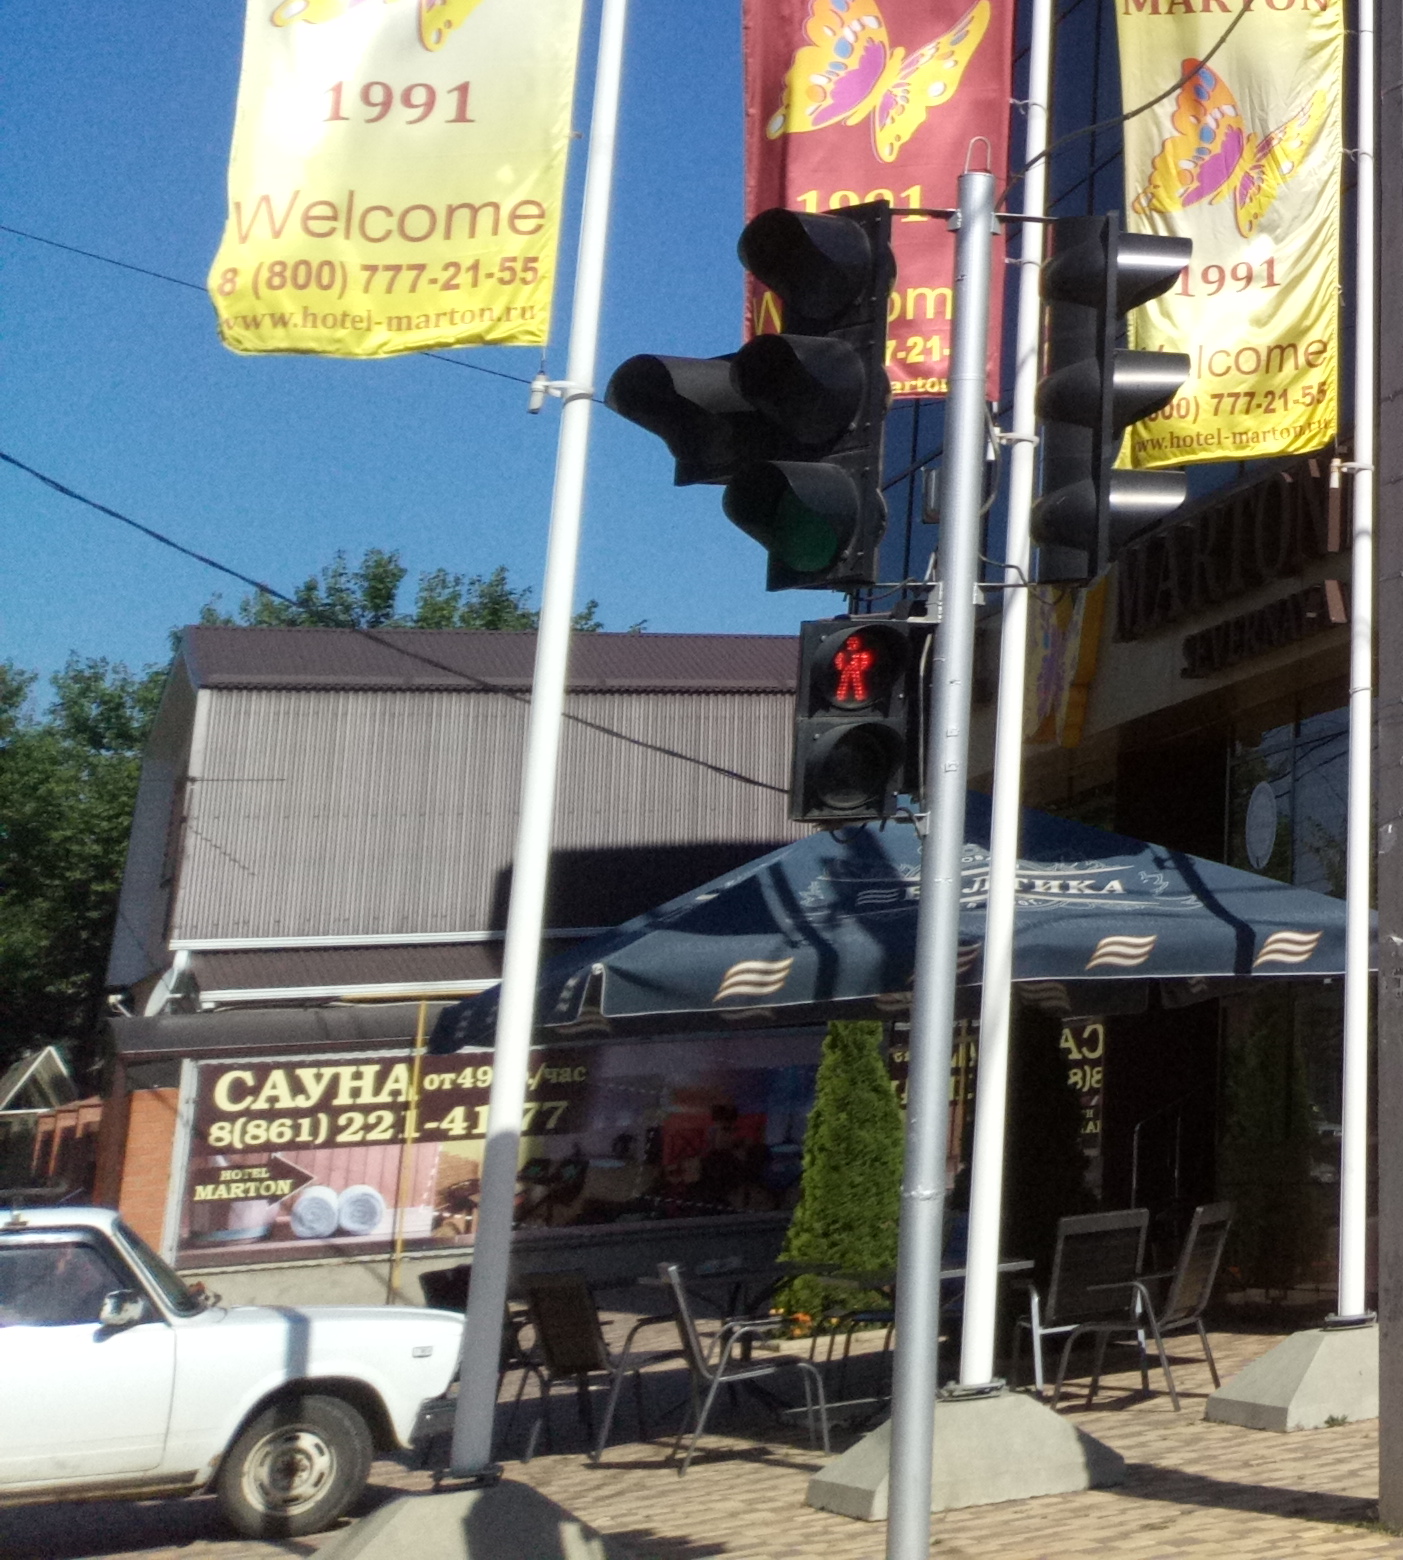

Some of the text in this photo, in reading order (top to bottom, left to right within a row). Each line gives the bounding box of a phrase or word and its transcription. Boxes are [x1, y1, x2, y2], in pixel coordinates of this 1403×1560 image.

[324, 81, 477, 125] 1991
[233, 190, 546, 244] Welcome
[217, 256, 541, 300] 8 (800) 777-21-55
[1175, 256, 1282, 298] 1991
[220, 304, 537, 333] www.hotel-marton.ru
[1210, 381, 1328, 417] 777-21-55
[213, 1062, 419, 1112] САУНА
[208, 1112, 330, 1150] 8(861)
[193, 1179, 293, 1201] MARTON
[220, 1167, 271, 1181] HOTEL
